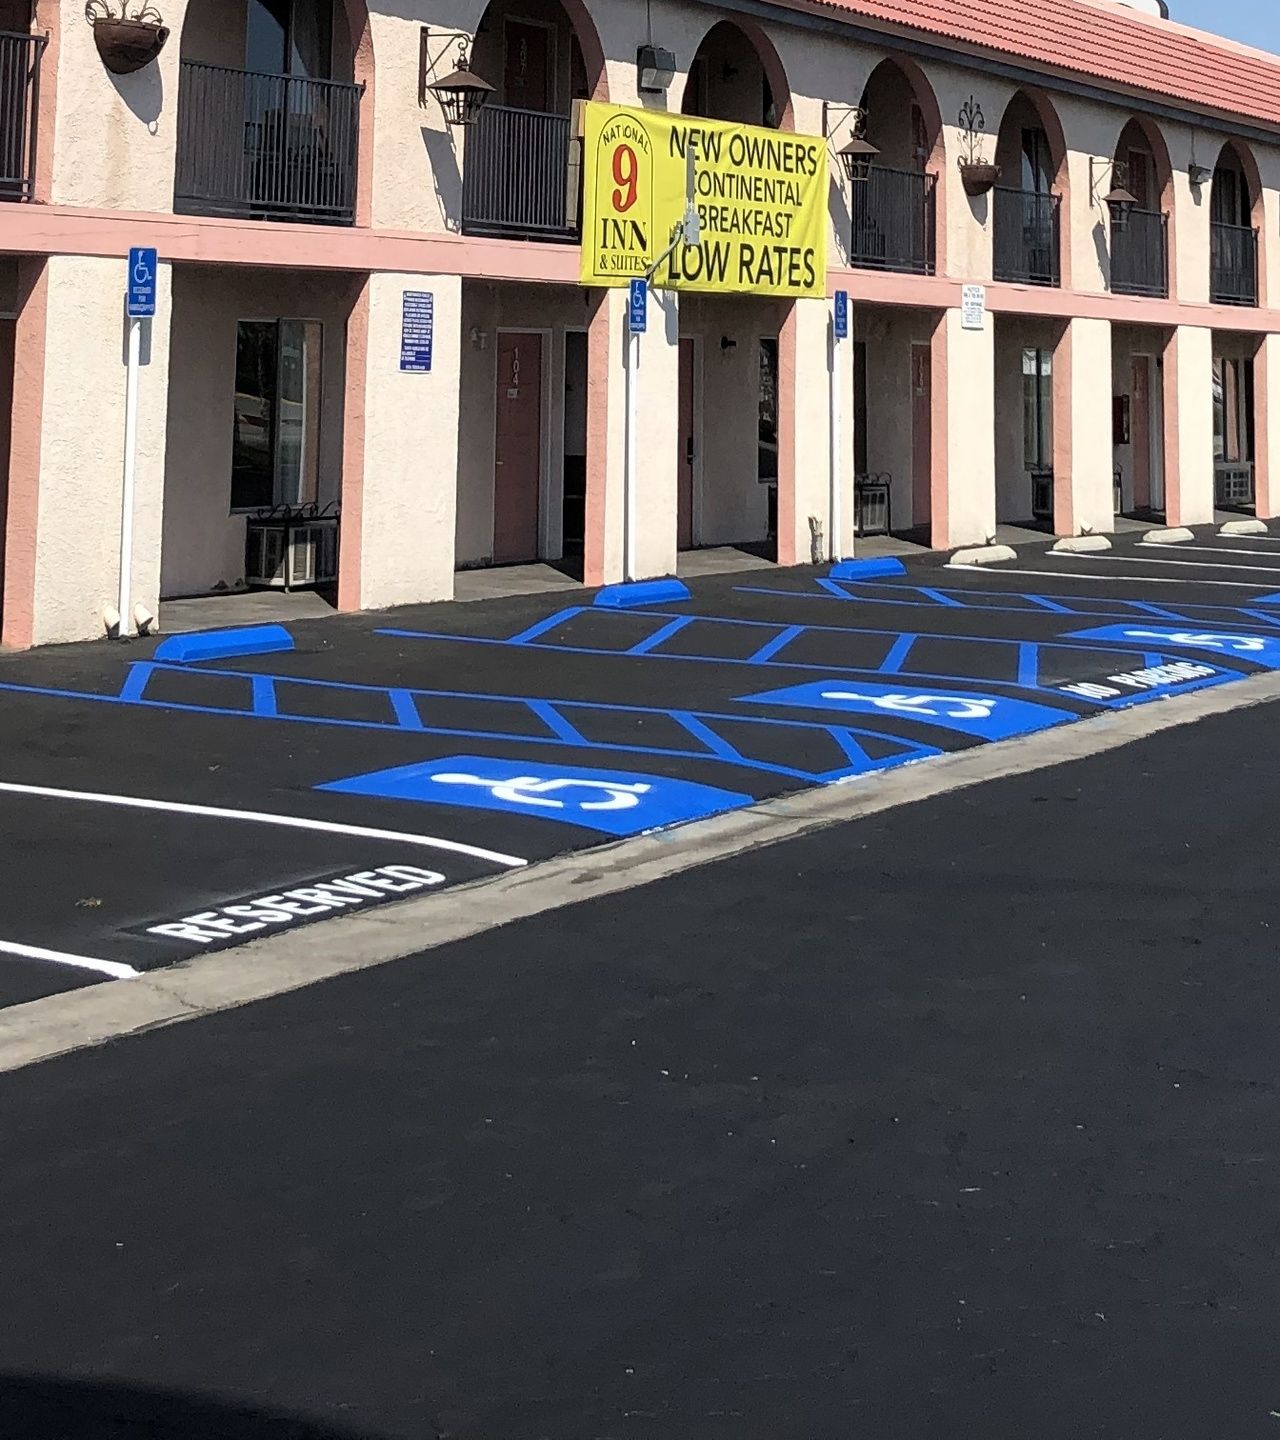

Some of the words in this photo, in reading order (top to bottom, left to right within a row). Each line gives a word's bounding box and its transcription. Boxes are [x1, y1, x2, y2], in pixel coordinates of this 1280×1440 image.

[603, 125, 648, 154] NATIONAL
[670, 126, 723, 163] NEW
[729, 134, 817, 176] OWNERS
[612, 144, 638, 213] 9
[694, 169, 802, 206] ONTINENTAL
[601, 218, 647, 252] INN
[697, 204, 793, 238] BREAKFAST
[600, 254, 608, 271] &
[610, 254, 648, 272] SUITES
[669, 237, 731, 283] LOW
[738, 243, 815, 289] RATES
[512, 346, 520, 386] 104
[1058, 682, 1121, 700] NO
[1106, 661, 1216, 689] PARKING
[145, 864, 447, 944] RESERVED
